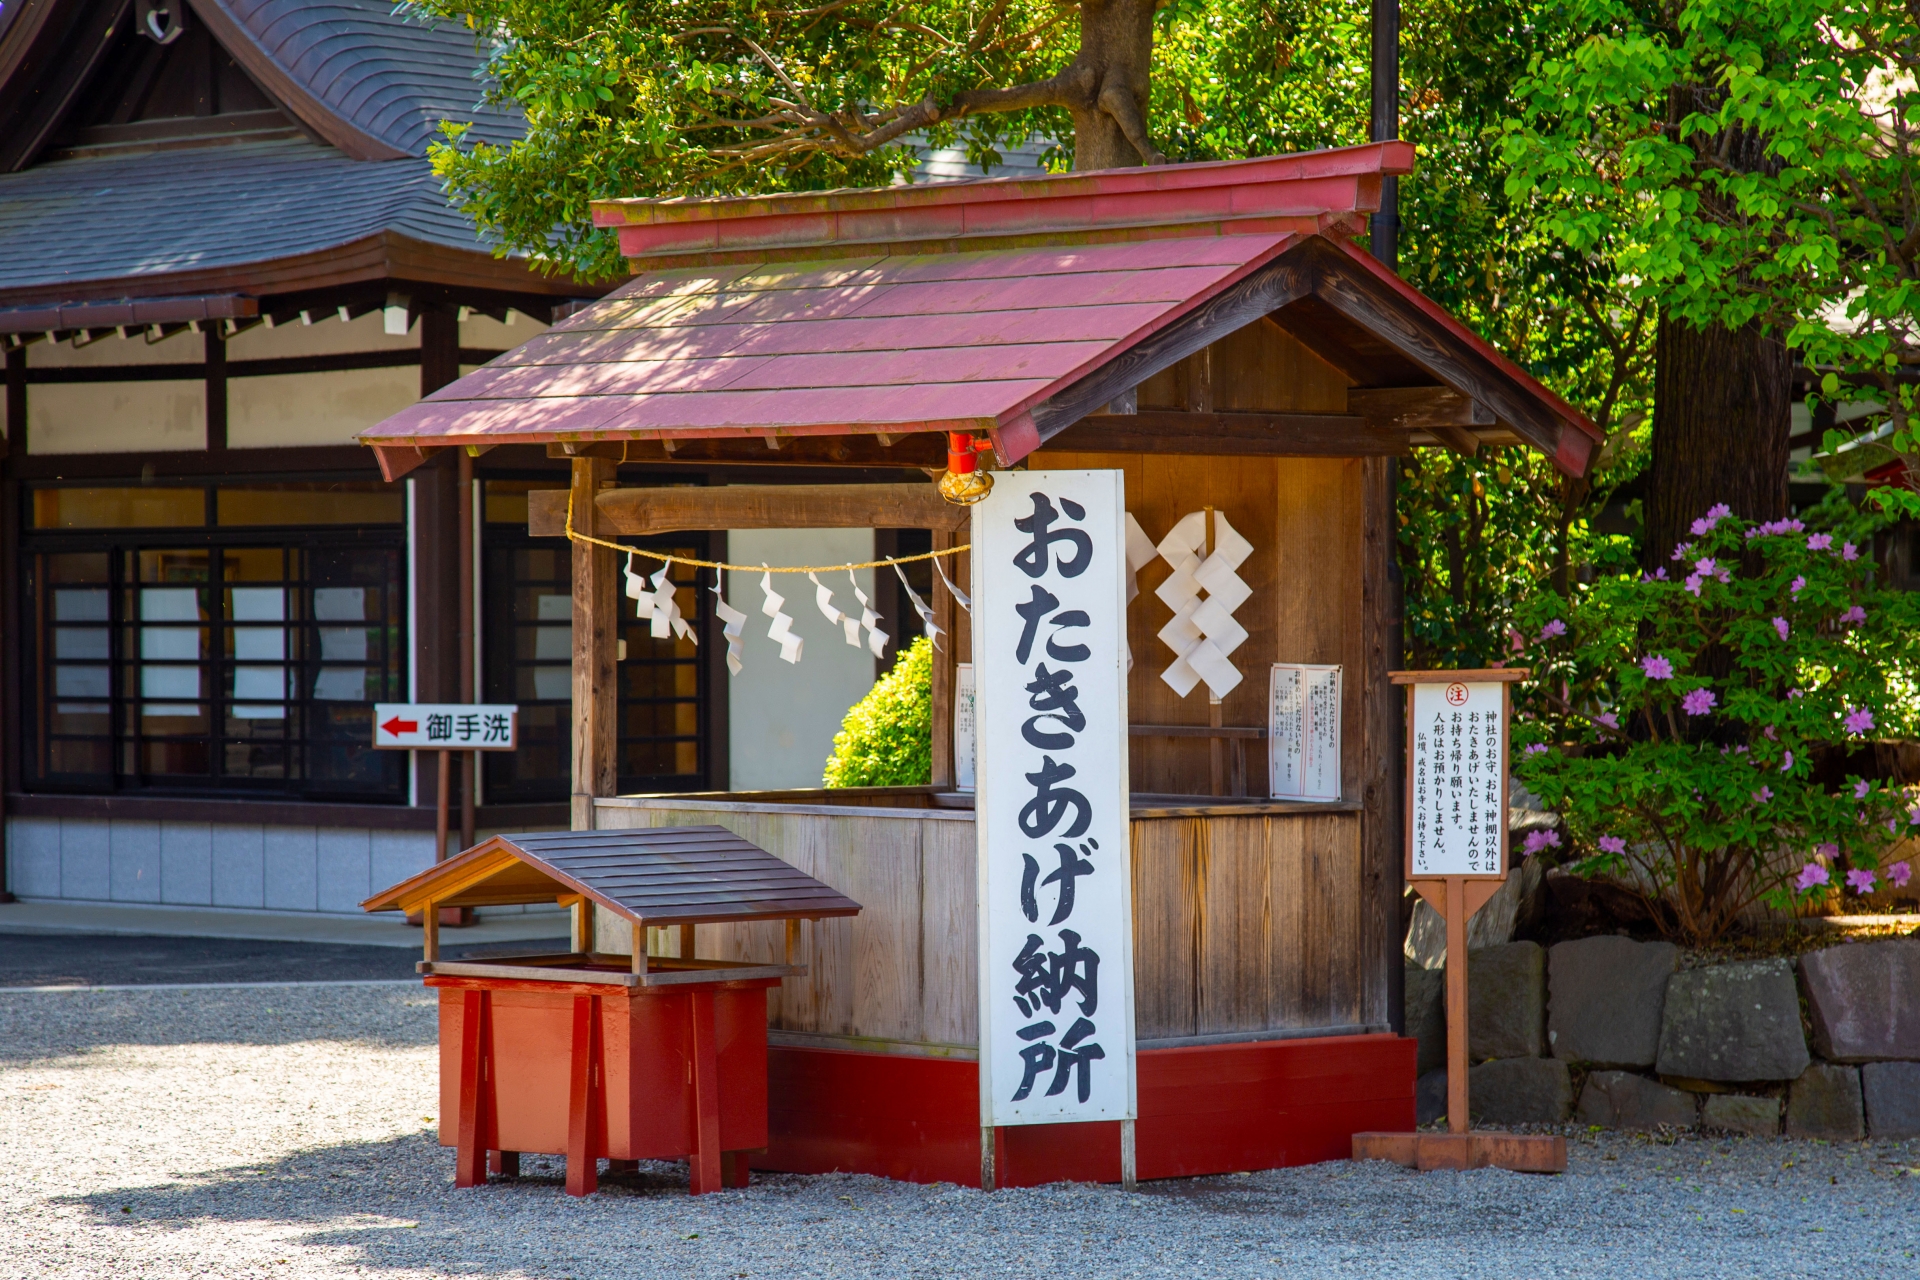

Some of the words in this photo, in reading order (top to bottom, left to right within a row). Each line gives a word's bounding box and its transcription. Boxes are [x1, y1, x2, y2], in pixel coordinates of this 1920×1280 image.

[426, 713, 509, 742] 御手洗
[1011, 491, 1105, 1104] おたきあげ納所
[1433, 712, 1446, 854] 人形はお預かりしません。
[1450, 711, 1463, 830] お持ち帰り願います。
[1468, 711, 1481, 871] おたきあげいたしませんので
[1485, 711, 1498, 871] 神社のお守、お札、神棚以外は
